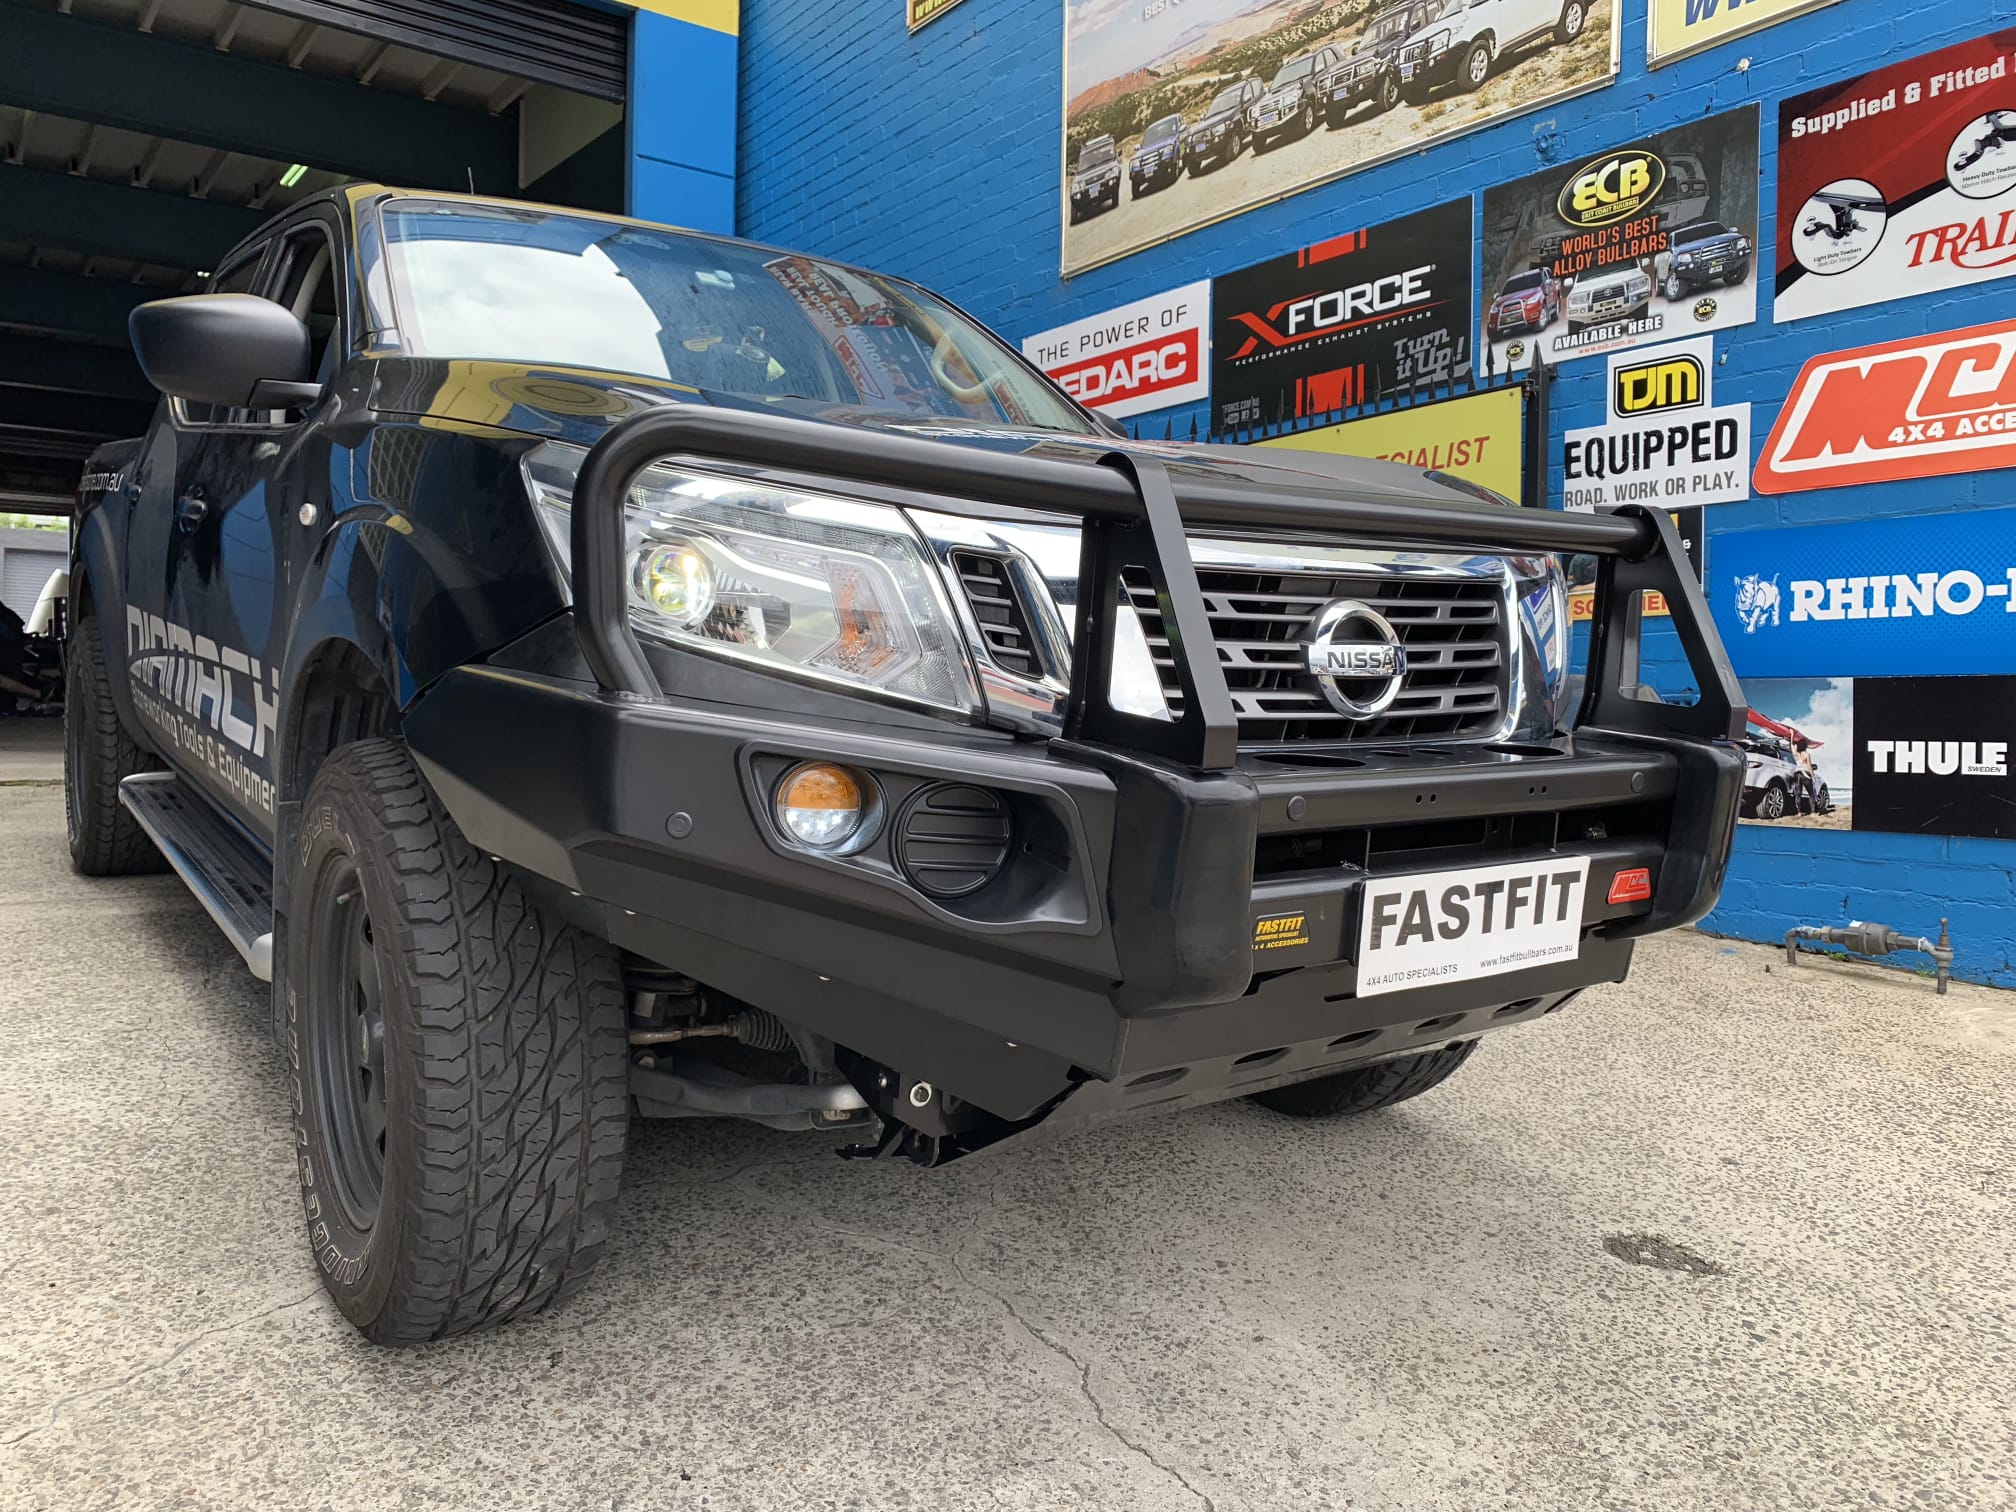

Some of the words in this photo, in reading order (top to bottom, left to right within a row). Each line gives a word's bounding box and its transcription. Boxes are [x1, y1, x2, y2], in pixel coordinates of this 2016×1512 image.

[1791, 88, 1896, 138] Supplied
[1904, 82, 1922, 104] &
[1929, 56, 2006, 98] Fitted
[1572, 158, 1651, 211] ECB
[1553, 251, 1593, 277] ALLOY
[1597, 231, 1668, 266] BULLBARS
[1561, 225, 1620, 256] WORLD'S
[1624, 214, 1659, 240] BEST
[1224, 264, 1436, 361] XFORCE
[1037, 341, 1070, 365] THE
[1080, 315, 1150, 353] POWER
[1160, 303, 1188, 328] OF
[1235, 342, 1310, 367] PERFORMANCE
[1318, 327, 1369, 346] EXHAUST
[1377, 311, 1432, 331] SYSTEMS
[1393, 328, 1451, 360] Turn
[1553, 322, 1622, 352] AVAILABLE
[1628, 314, 1663, 335] HERE
[1620, 361, 1698, 412] TJM
[1777, 341, 2016, 463] MC
[1887, 421, 1946, 444] 4X4
[1954, 411, 2016, 437] ACCE
[1376, 436, 1491, 470] IALIST
[1564, 418, 1739, 481] EQUIPPED
[1564, 486, 1608, 508] ROAD.
[1614, 479, 1659, 502] WORK
[1665, 476, 1686, 496] OR
[1692, 470, 1740, 493] PLAY.
[1327, 650, 1406, 670] NISSAN
[177, 714, 205, 761] Tools
[206, 735, 217, 769] &
[1867, 740, 2008, 776] THULE
[1967, 765, 2003, 774] SWEDEN
[1255, 916, 1305, 935] FASTFIT
[1369, 870, 1583, 951] FASTFIT
[1266, 937, 1309, 950] ACCESSORIES
[1479, 943, 1574, 969] www.fastfitbullbars.com.au
[1366, 975, 1382, 987] 4X4
[1382, 971, 1405, 985] AUTO
[1406, 963, 1459, 980] SPECIALISTS
